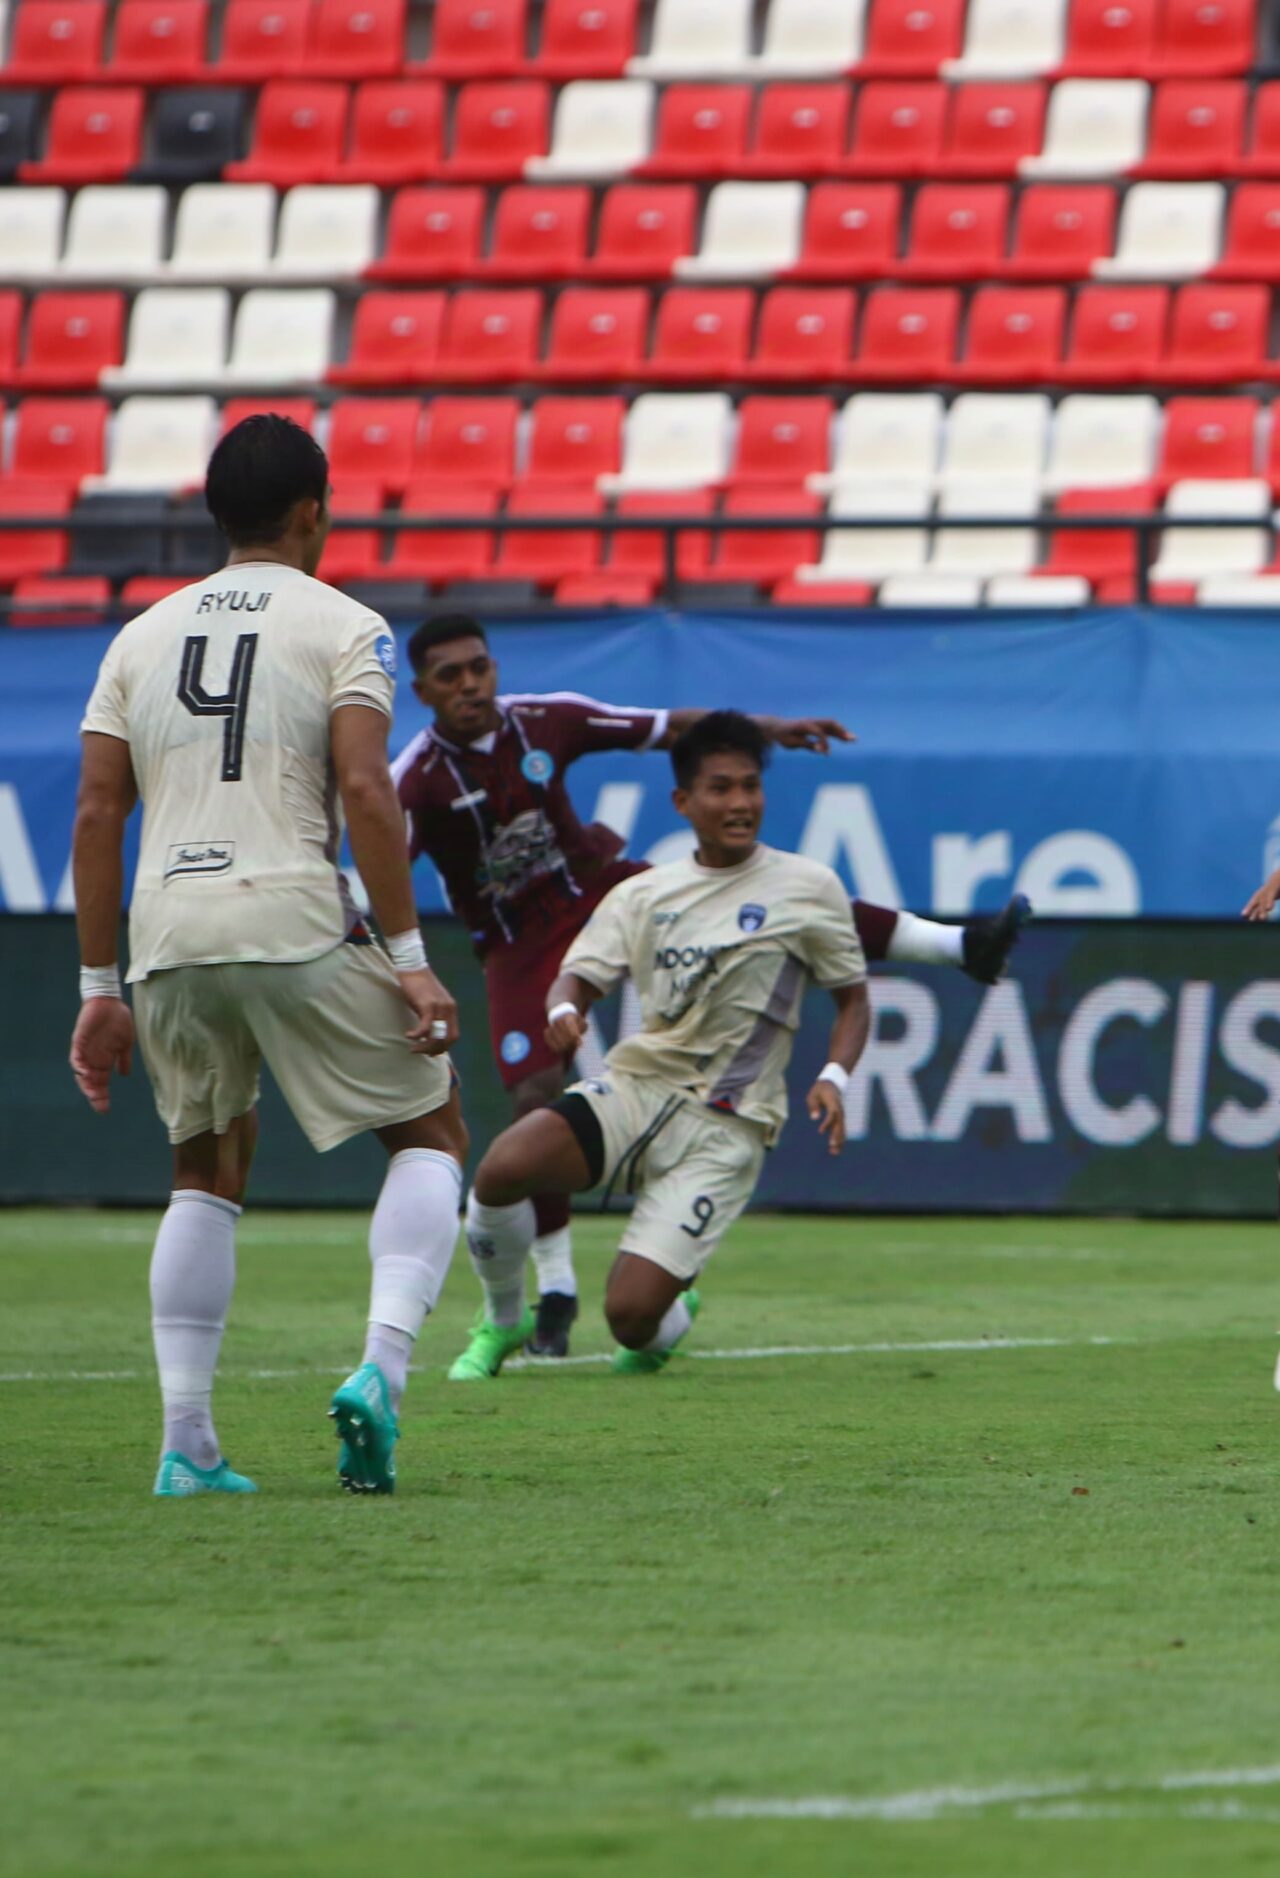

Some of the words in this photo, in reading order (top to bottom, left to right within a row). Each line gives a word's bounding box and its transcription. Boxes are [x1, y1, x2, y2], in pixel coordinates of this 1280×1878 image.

[177, 632, 259, 782] 4
[799, 783, 1143, 916] Are
[680, 1196, 715, 1239] 9
